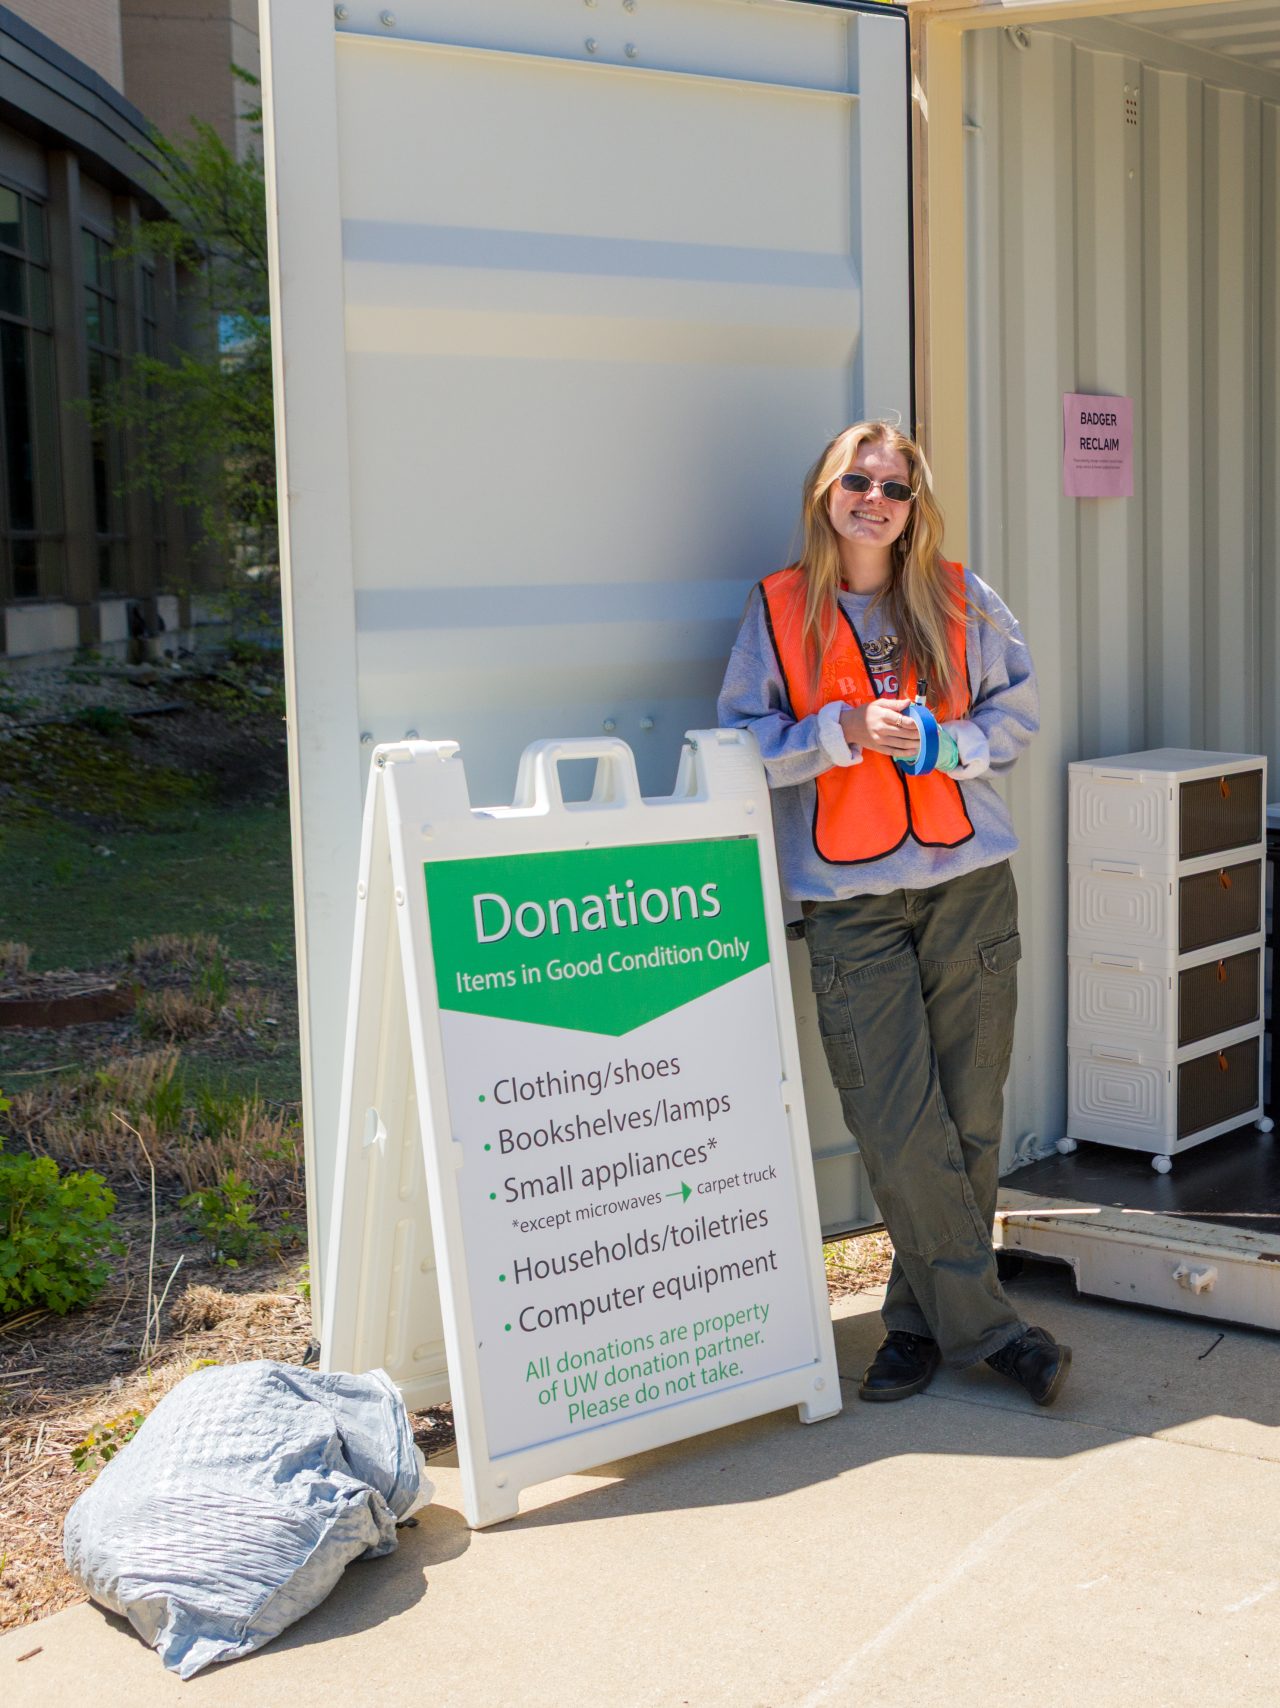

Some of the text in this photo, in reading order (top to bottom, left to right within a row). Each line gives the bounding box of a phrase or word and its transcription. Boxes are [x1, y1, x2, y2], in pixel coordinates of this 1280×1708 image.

[1079, 437, 1120, 451] RECLAIM
[1080, 411, 1117, 427] BADGER
[472, 879, 722, 945] Donations
[456, 936, 750, 993] Items in Good Condition Only
[493, 1057, 681, 1105] Clothing/shoes
[498, 1094, 731, 1155] Bookshelves/lamps
[504, 1164, 574, 1203] Small
[575, 1192, 662, 1221] microwaves
[697, 1174, 740, 1195] carpet
[742, 1164, 777, 1185] truck
[513, 1209, 769, 1285] Households/toiletries
[518, 1249, 778, 1333] Computer equipment
[525, 1303, 770, 1383] All donations are property
[538, 1330, 765, 1405] of UW donation partner.
[568, 1362, 744, 1425] Please do not take.
